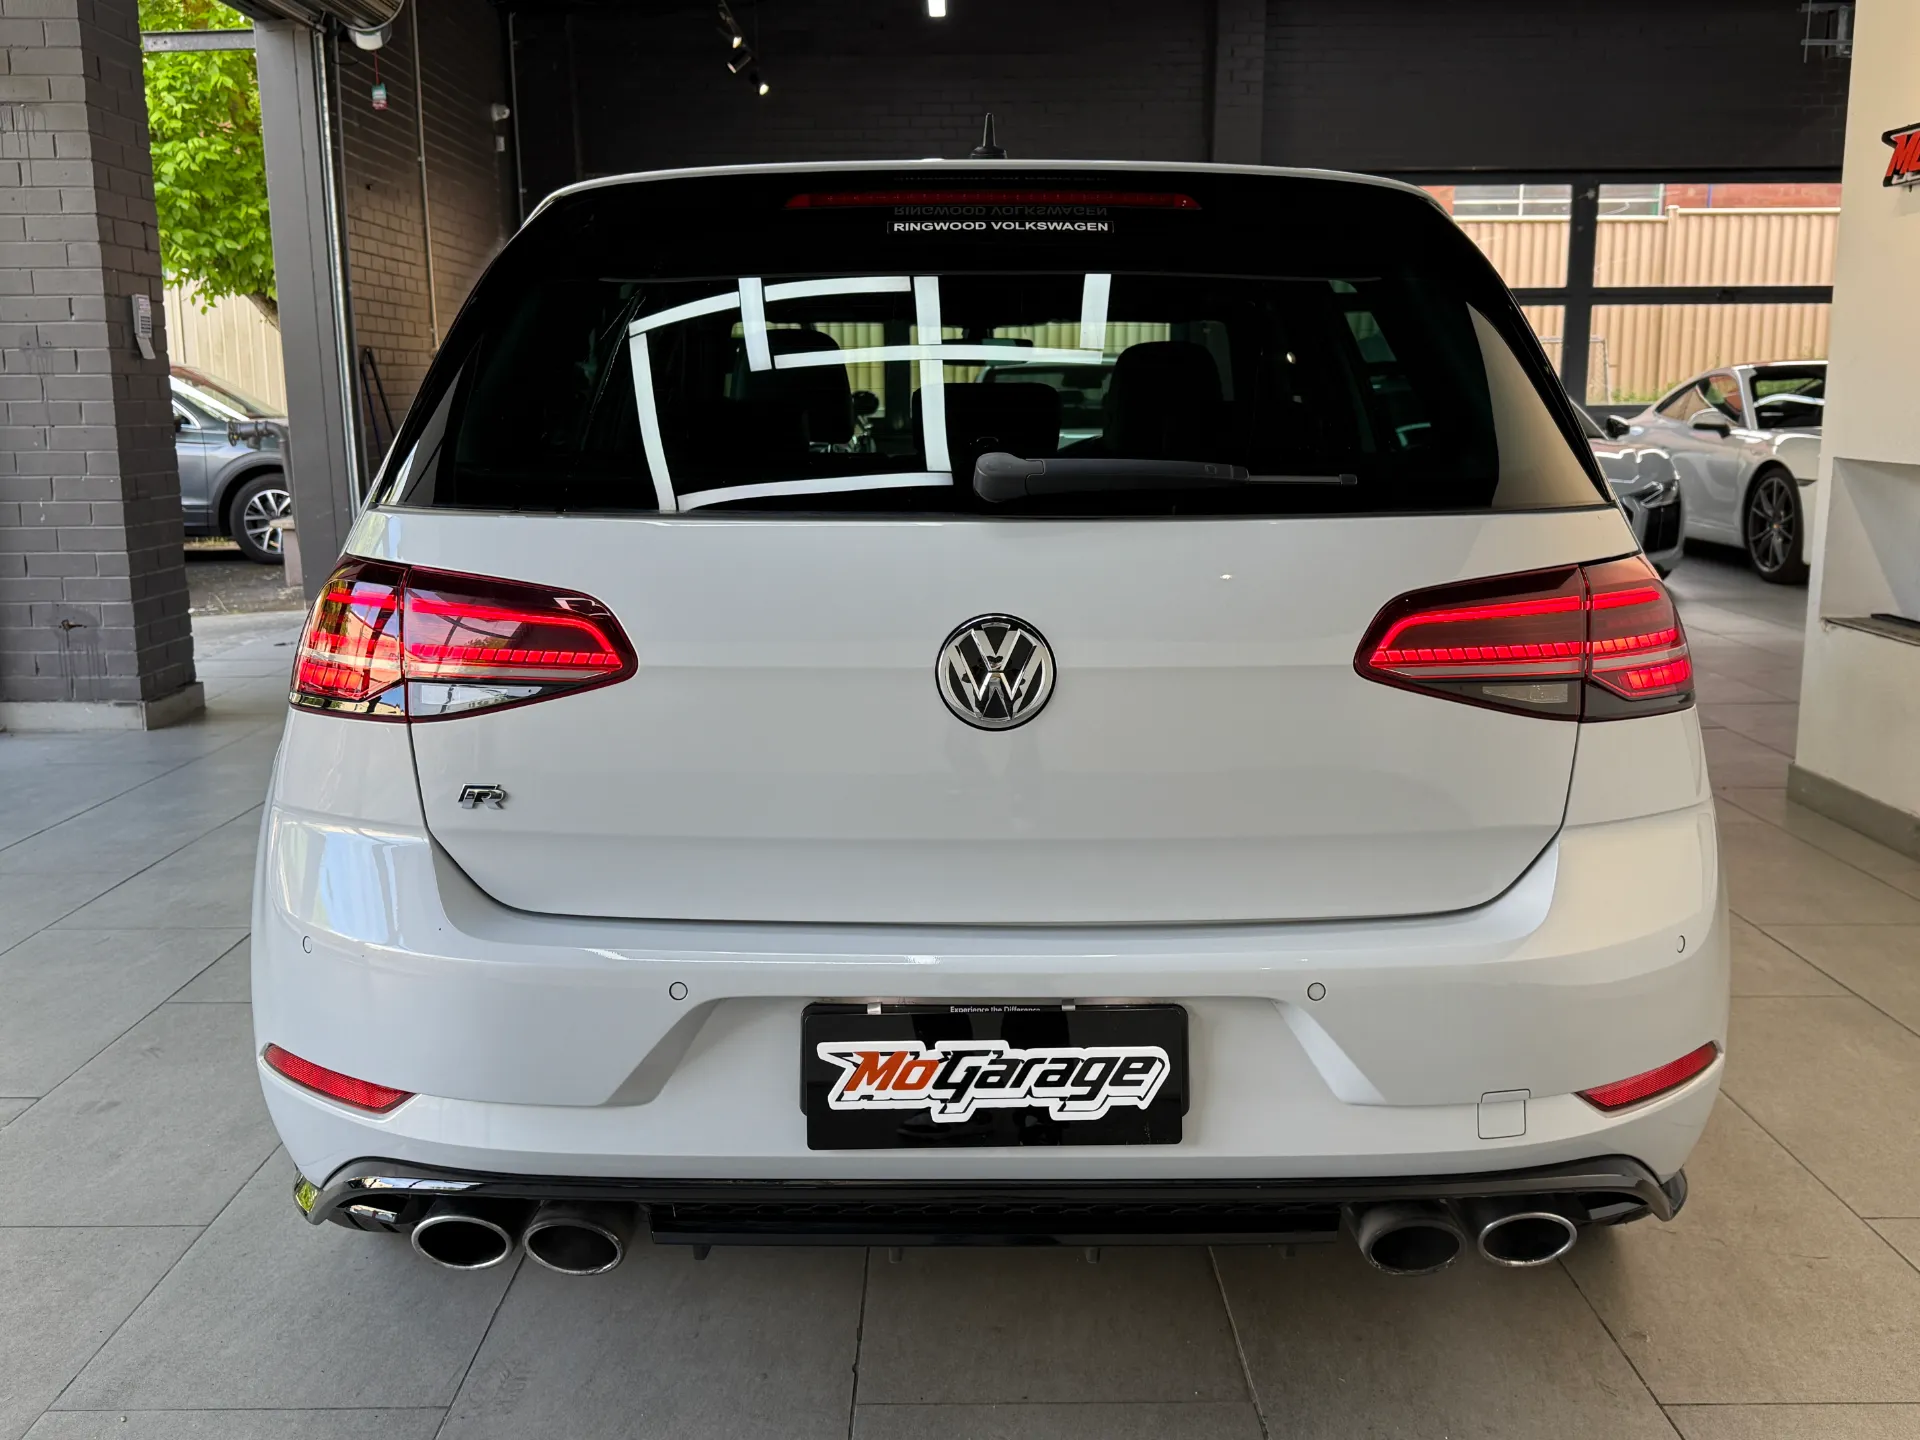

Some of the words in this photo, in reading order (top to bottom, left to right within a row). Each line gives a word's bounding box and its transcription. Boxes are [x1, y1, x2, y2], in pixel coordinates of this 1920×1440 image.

[893, 221, 987, 232] RINGWOOD
[990, 221, 1109, 232] VOLKSWAGEN
[941, 622, 1050, 724] VW
